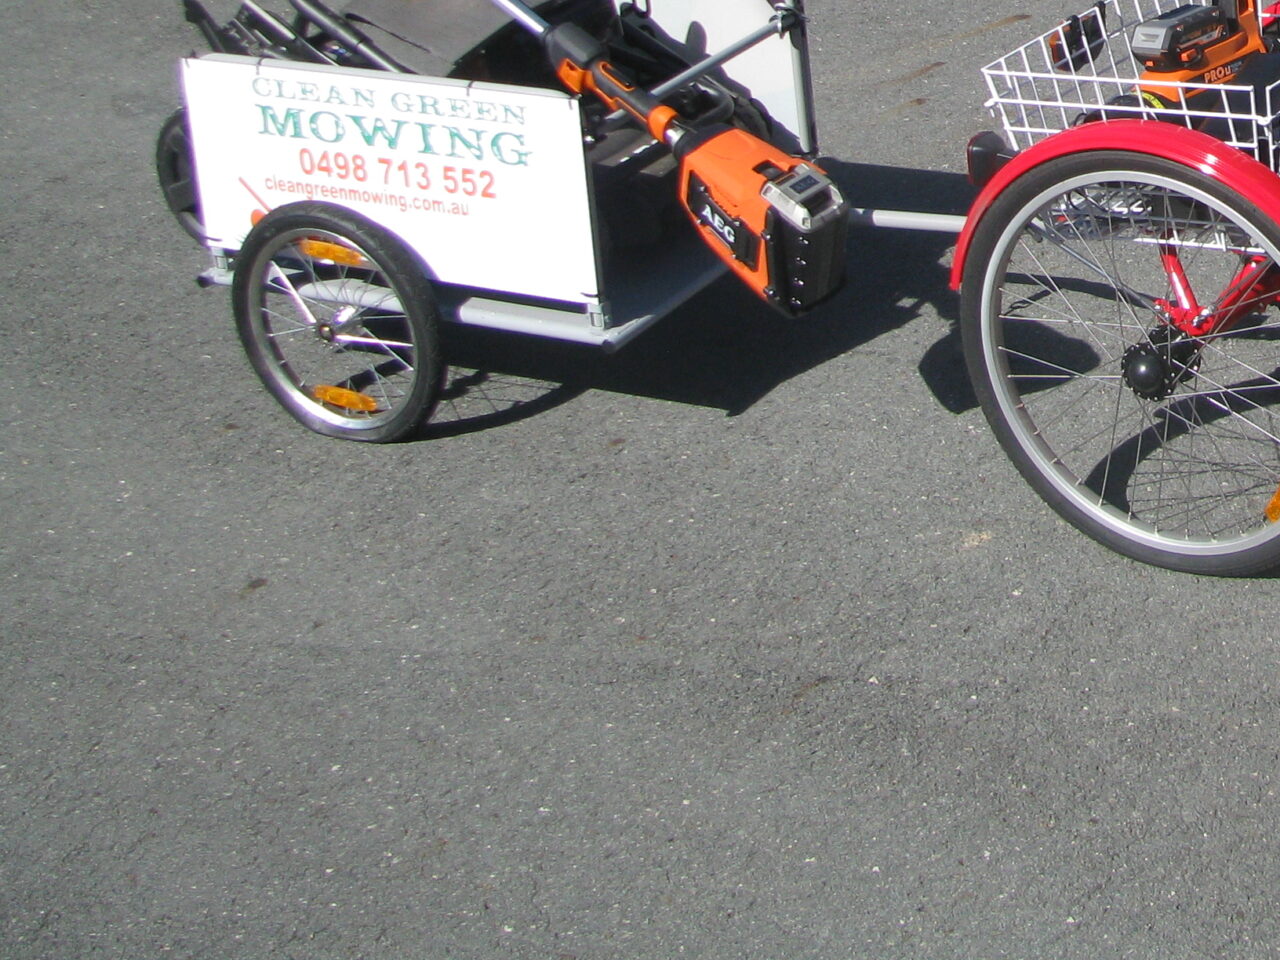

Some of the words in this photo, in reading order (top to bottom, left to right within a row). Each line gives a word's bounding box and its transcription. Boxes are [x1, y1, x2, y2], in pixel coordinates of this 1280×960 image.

[1204, 66, 1225, 84] PRO
[252, 76, 375, 108] CLEAN
[391, 91, 527, 125] GREEN
[254, 103, 533, 167] MOWING
[265, 174, 469, 216] cleangreenmowing.com.au
[299, 147, 368, 182] 0498
[378, 157, 432, 190] 713
[443, 165, 496, 199] 552
[701, 204, 735, 243] AEG
